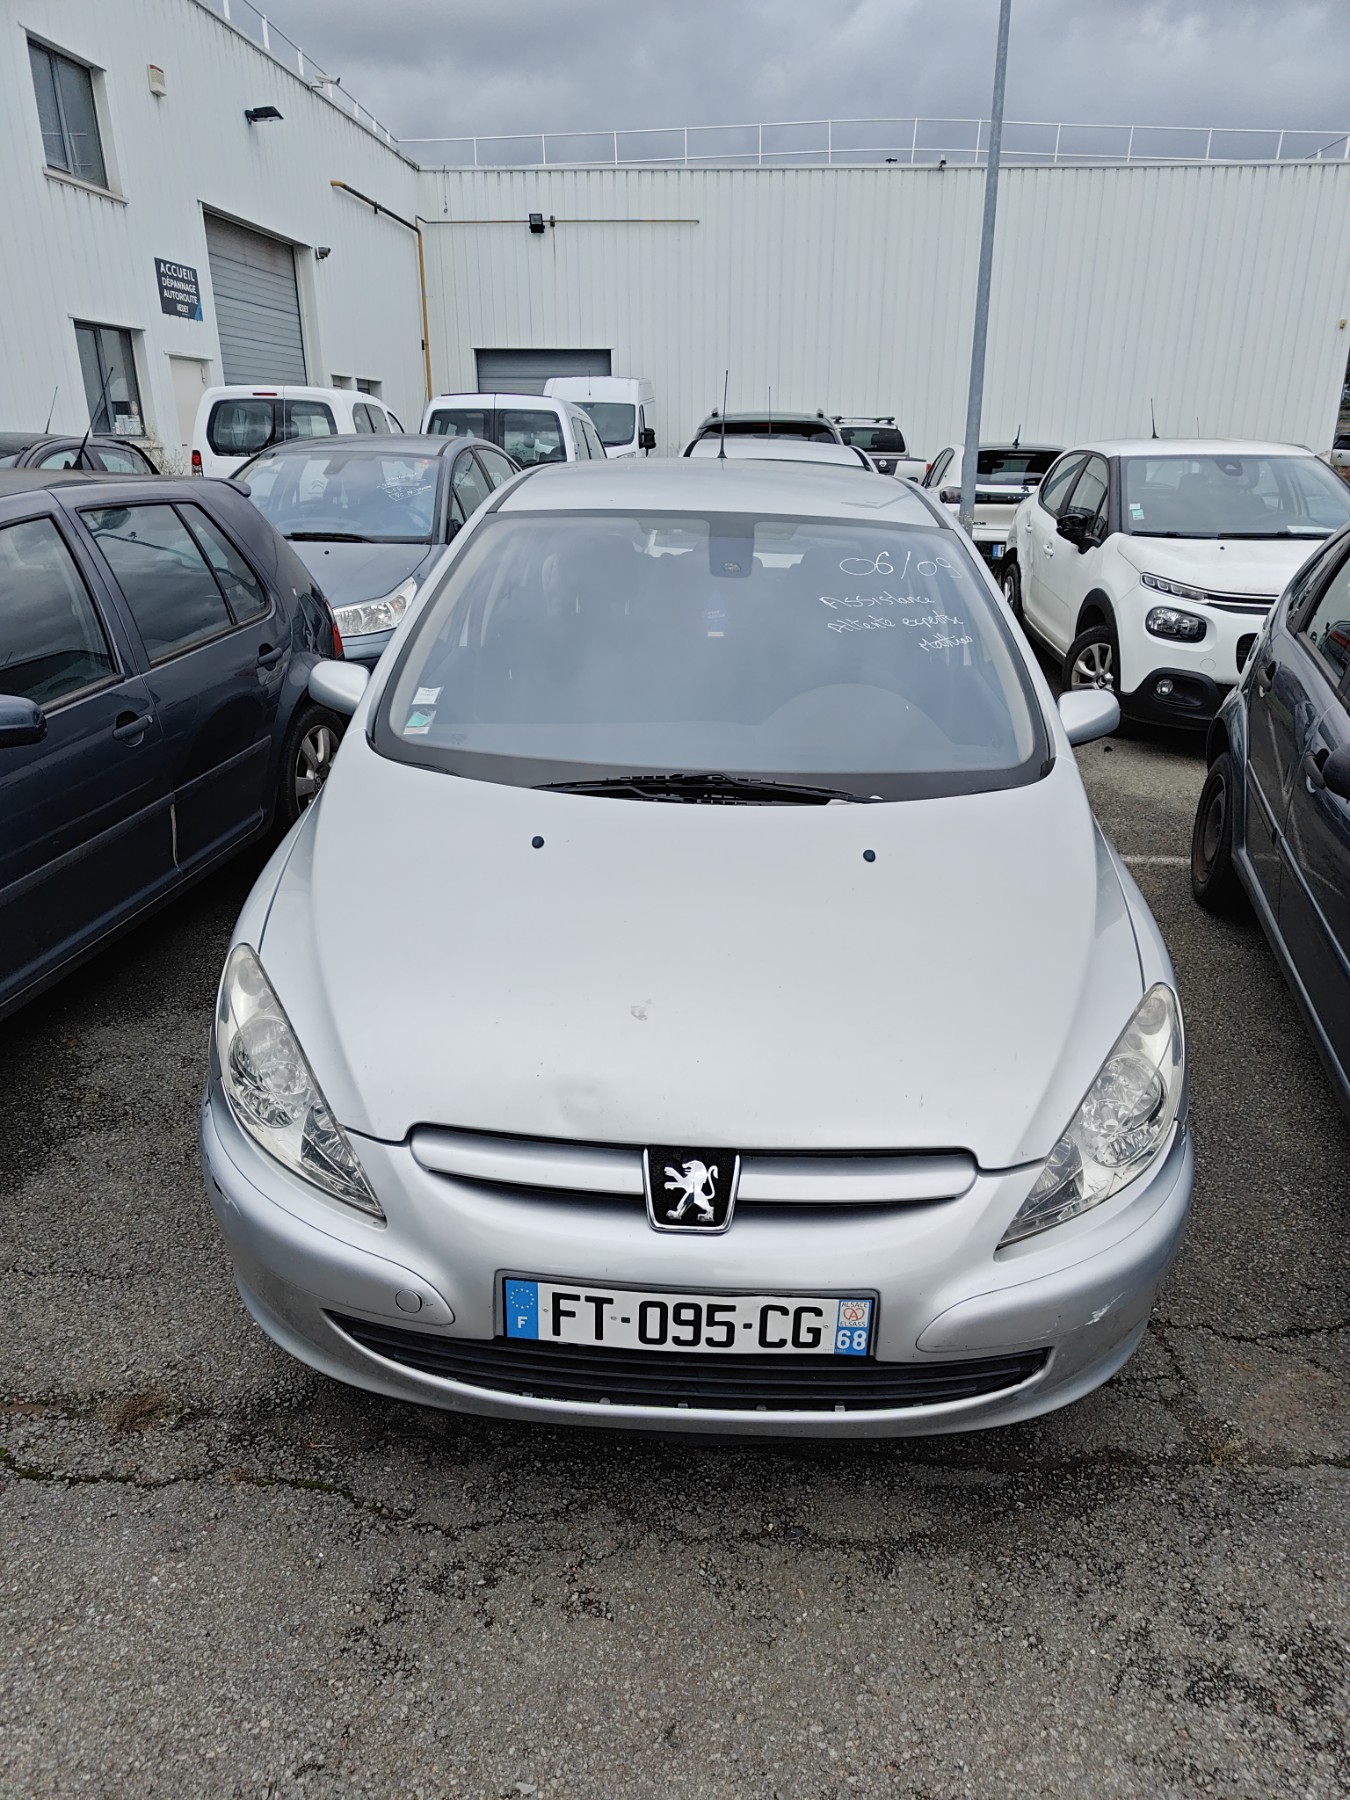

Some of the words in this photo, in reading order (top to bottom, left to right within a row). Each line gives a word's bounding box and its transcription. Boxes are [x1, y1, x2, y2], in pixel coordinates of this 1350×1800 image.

[160, 262, 195, 282] ACCUEIL
[161, 276, 197, 294] DÉPANNAGE
[163, 289, 199, 305] AUTOROUTE
[839, 551, 963, 580] 06/09
[517, 1315, 528, 1329] F
[551, 1292, 823, 1349] FT-095-CG
[836, 1330, 867, 1351] 68
